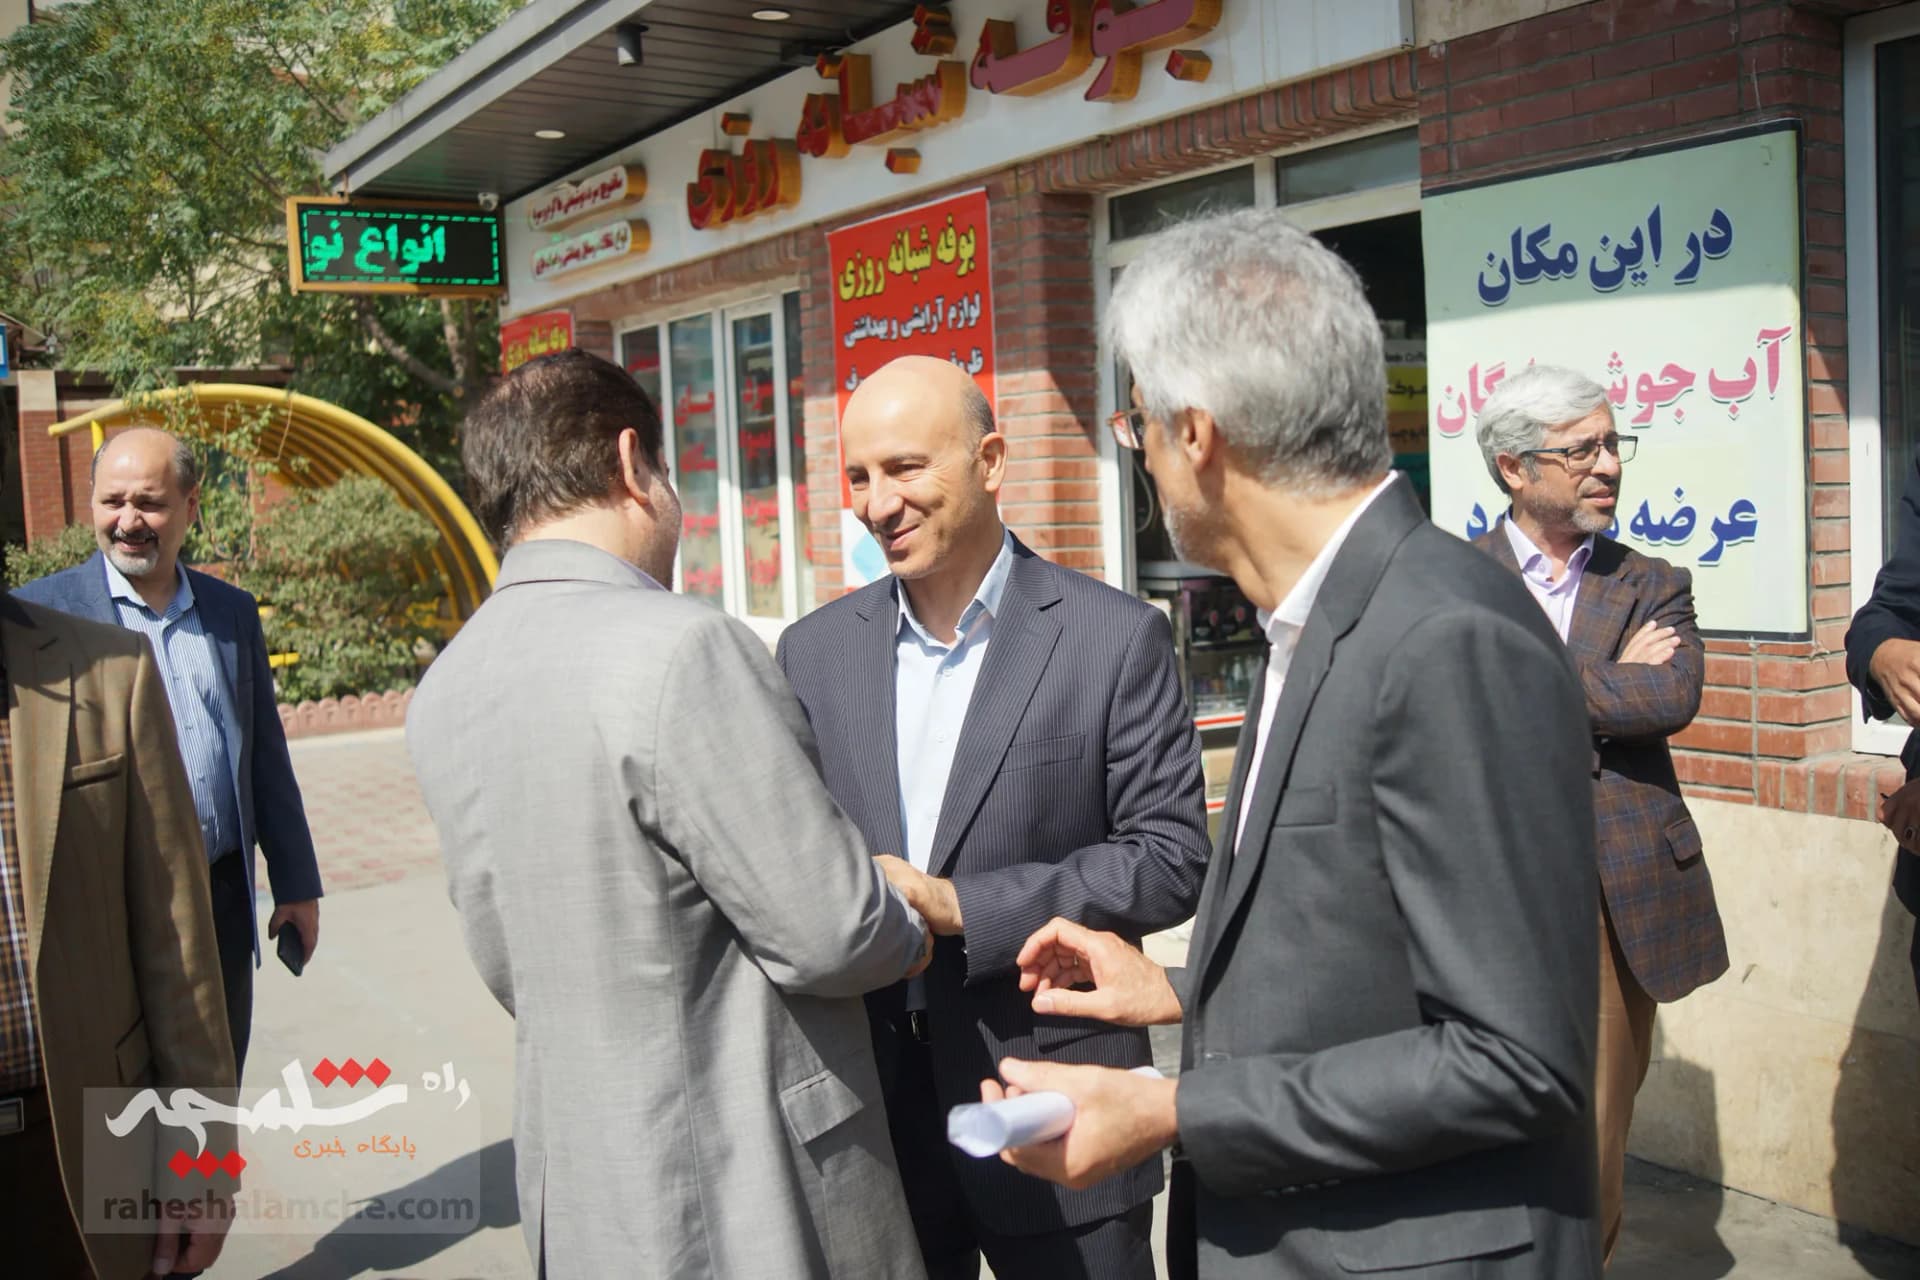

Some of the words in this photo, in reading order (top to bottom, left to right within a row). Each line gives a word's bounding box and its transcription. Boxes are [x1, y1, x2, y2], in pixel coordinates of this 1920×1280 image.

[794, 4, 966, 174] شبانه
[686, 111, 800, 231] روزی
[353, 221, 445, 274] انواع
[839, 250, 885, 302] روزی
[887, 224, 932, 283] شبانه
[935, 213, 976, 277] بوفه
[1477, 222, 1579, 306] مکان
[1589, 203, 1664, 292] این
[1673, 207, 1734, 284] در
[844, 314, 889, 348] بهداشتی
[889, 318, 898, 340] و
[900, 296, 945, 338] آرایشی
[947, 291, 981, 329] لوازم
[1707, 326, 1793, 420] آب
[1629, 487, 1759, 566] عرضه
